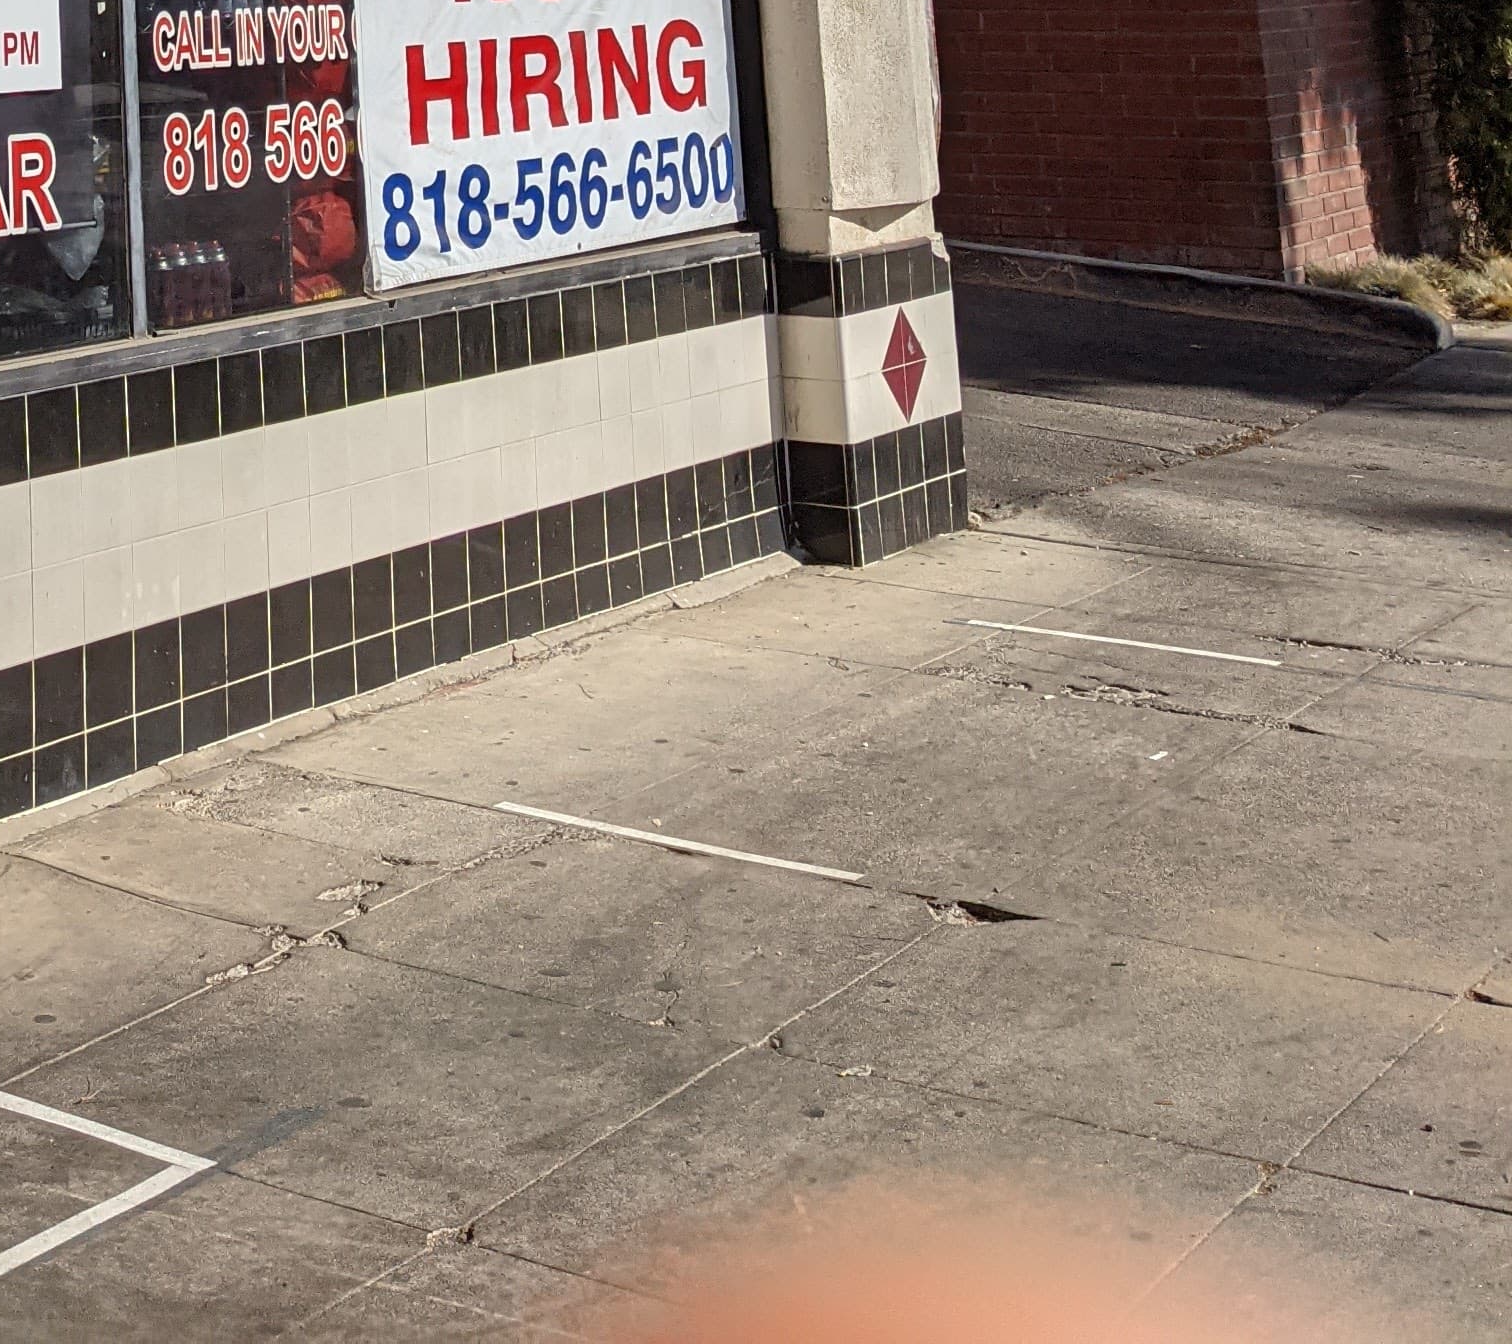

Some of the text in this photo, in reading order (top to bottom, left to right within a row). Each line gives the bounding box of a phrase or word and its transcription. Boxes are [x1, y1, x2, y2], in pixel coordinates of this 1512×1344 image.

[3, 31, 40, 65] PM
[153, 10, 231, 72] CALL
[236, 7, 265, 66] IN
[268, 4, 349, 64] YOUR
[405, 18, 707, 146] HIRING
[164, 107, 252, 196] 818
[265, 98, 346, 183] 566
[382, 132, 733, 261] 818-566-6500
